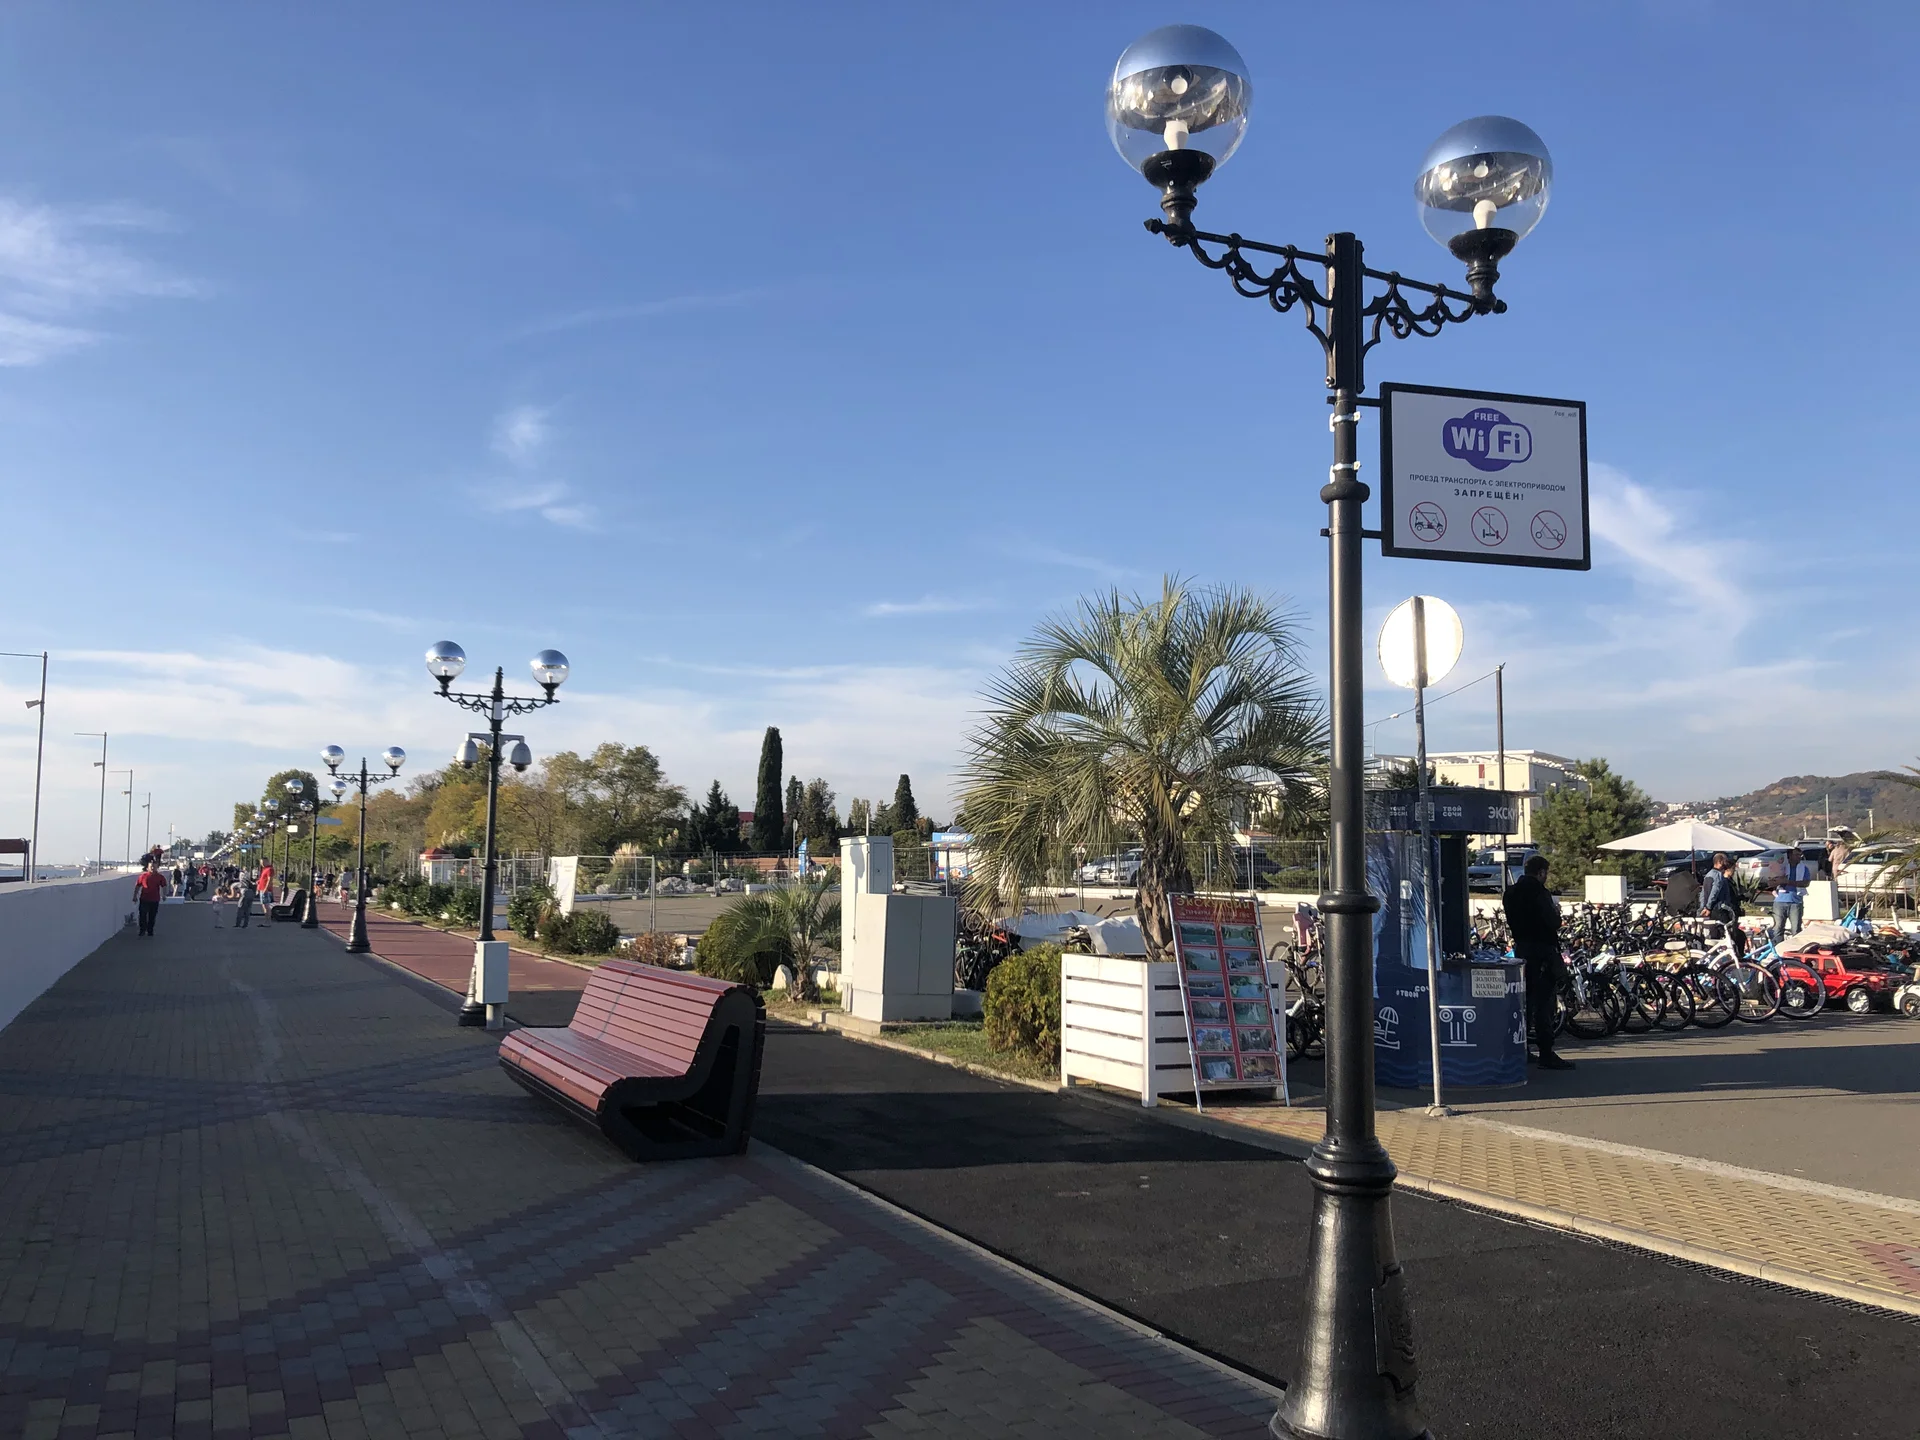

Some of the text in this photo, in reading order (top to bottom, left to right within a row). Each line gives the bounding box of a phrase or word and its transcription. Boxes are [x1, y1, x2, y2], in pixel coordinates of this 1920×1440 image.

[1474, 412, 1500, 422] FREE
[1409, 473, 1439, 484] ПРОЕЗД
[1440, 476, 1487, 486] ТРАНСПОРТА
[1495, 480, 1566, 492] ЭЛЕКТРОПРИВОДОМ
